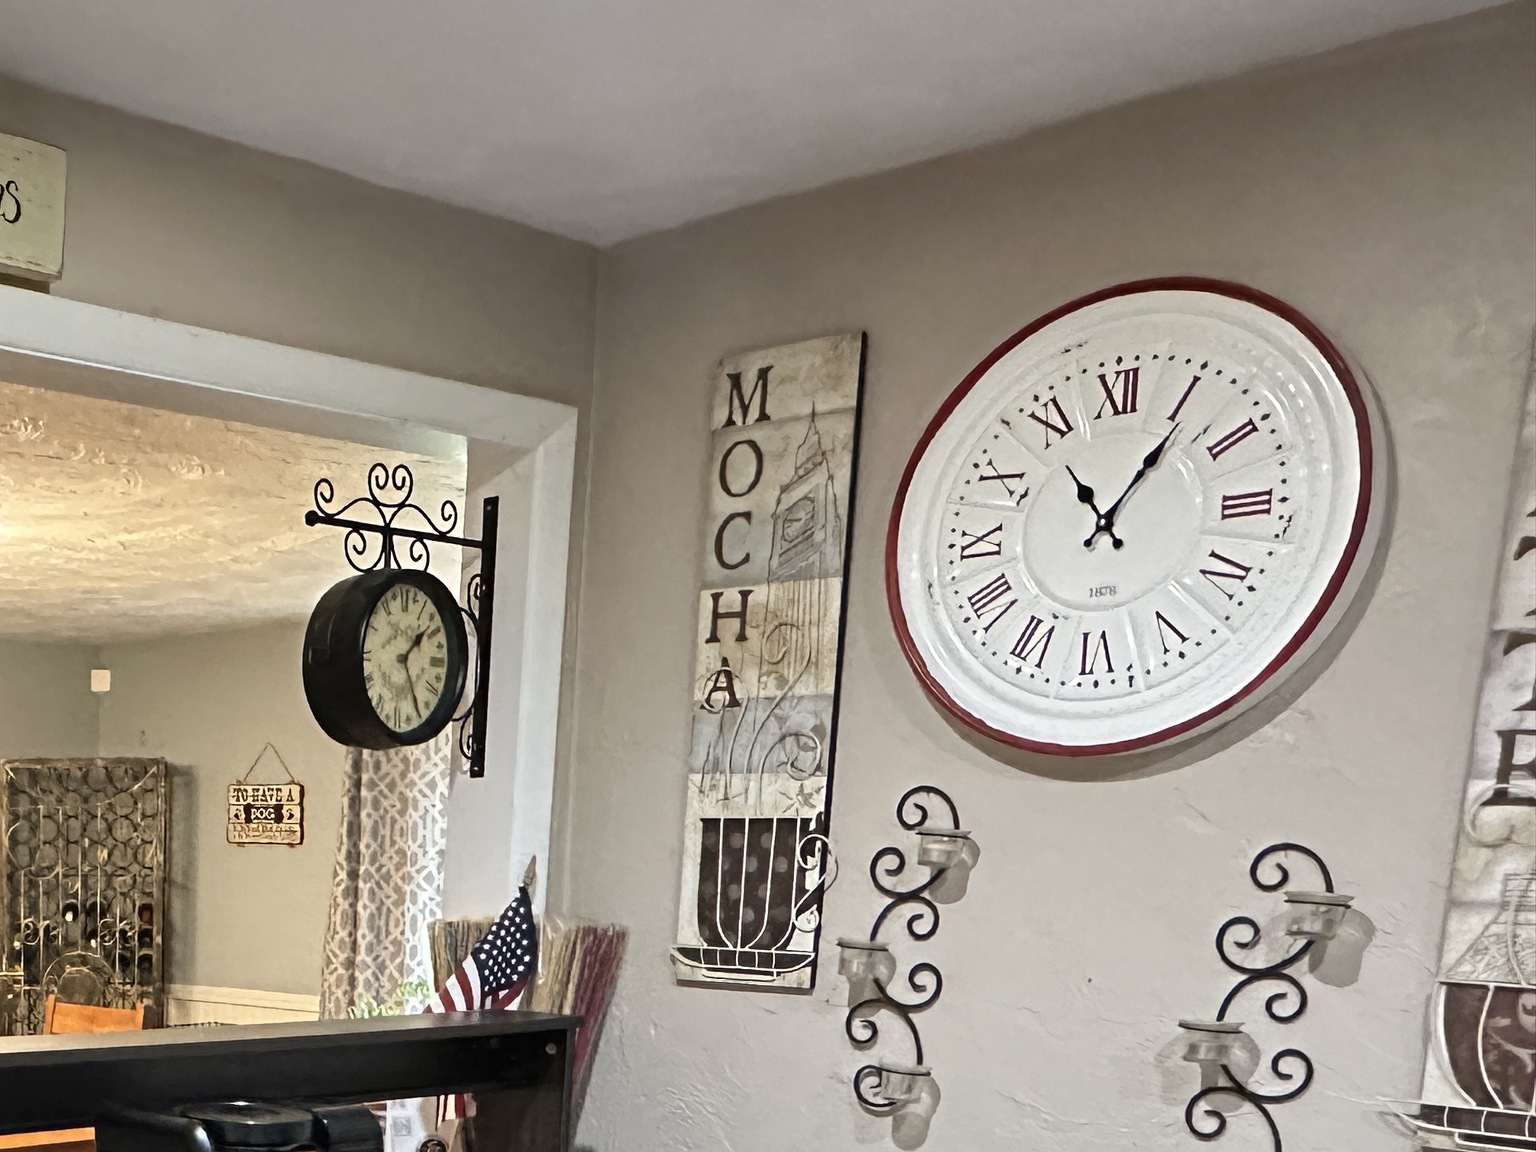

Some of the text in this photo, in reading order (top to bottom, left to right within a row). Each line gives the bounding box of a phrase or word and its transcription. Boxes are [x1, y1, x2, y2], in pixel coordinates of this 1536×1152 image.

[1094, 367, 1140, 420] XII
[1168, 375, 1201, 422] I
[1027, 396, 1074, 450] XI
[1206, 418, 1259, 462] II
[978, 459, 1026, 497] X
[1221, 488, 1274, 520] III
[704, 365, 774, 711] MOCHA
[960, 523, 1003, 561] IX
[1199, 549, 1253, 601] IV
[967, 573, 1018, 633] VIII
[1009, 615, 1056, 669] VII
[1079, 630, 1115, 676] VI
[1155, 610, 1190, 655] V
[251, 808, 276, 819] DOG
[286, 787, 295, 802] A
